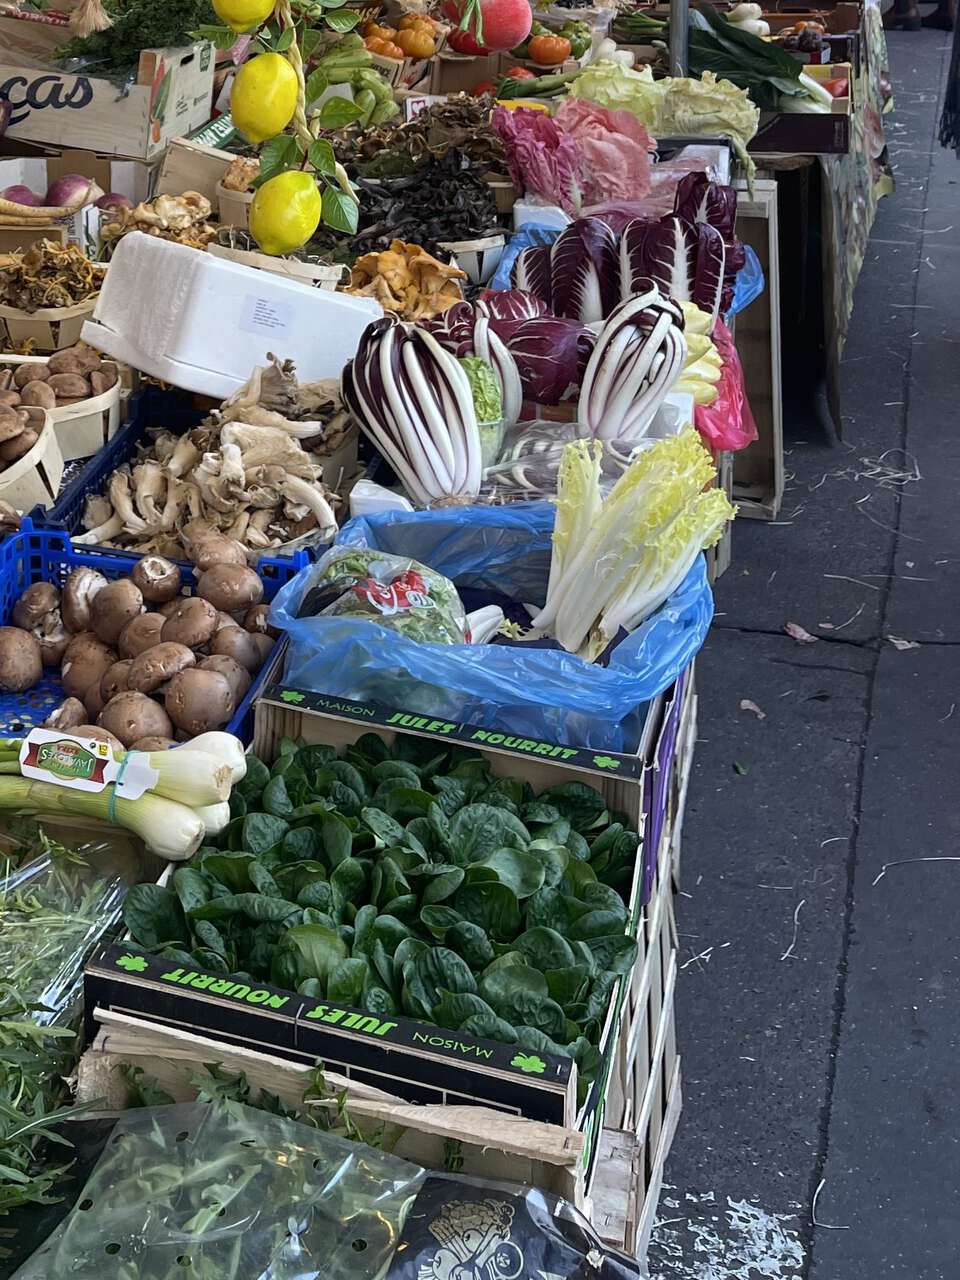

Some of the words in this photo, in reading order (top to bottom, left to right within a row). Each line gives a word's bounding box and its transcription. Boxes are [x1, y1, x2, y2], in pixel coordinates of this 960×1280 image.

[315, 698, 376, 717] MAISON
[386, 712, 458, 735] JULES
[470, 729, 581, 760] NOURRIT
[160, 967, 291, 1010] NOURRIT
[304, 1004, 398, 1037] JULES
[412, 1030, 494, 1060] MAISON
